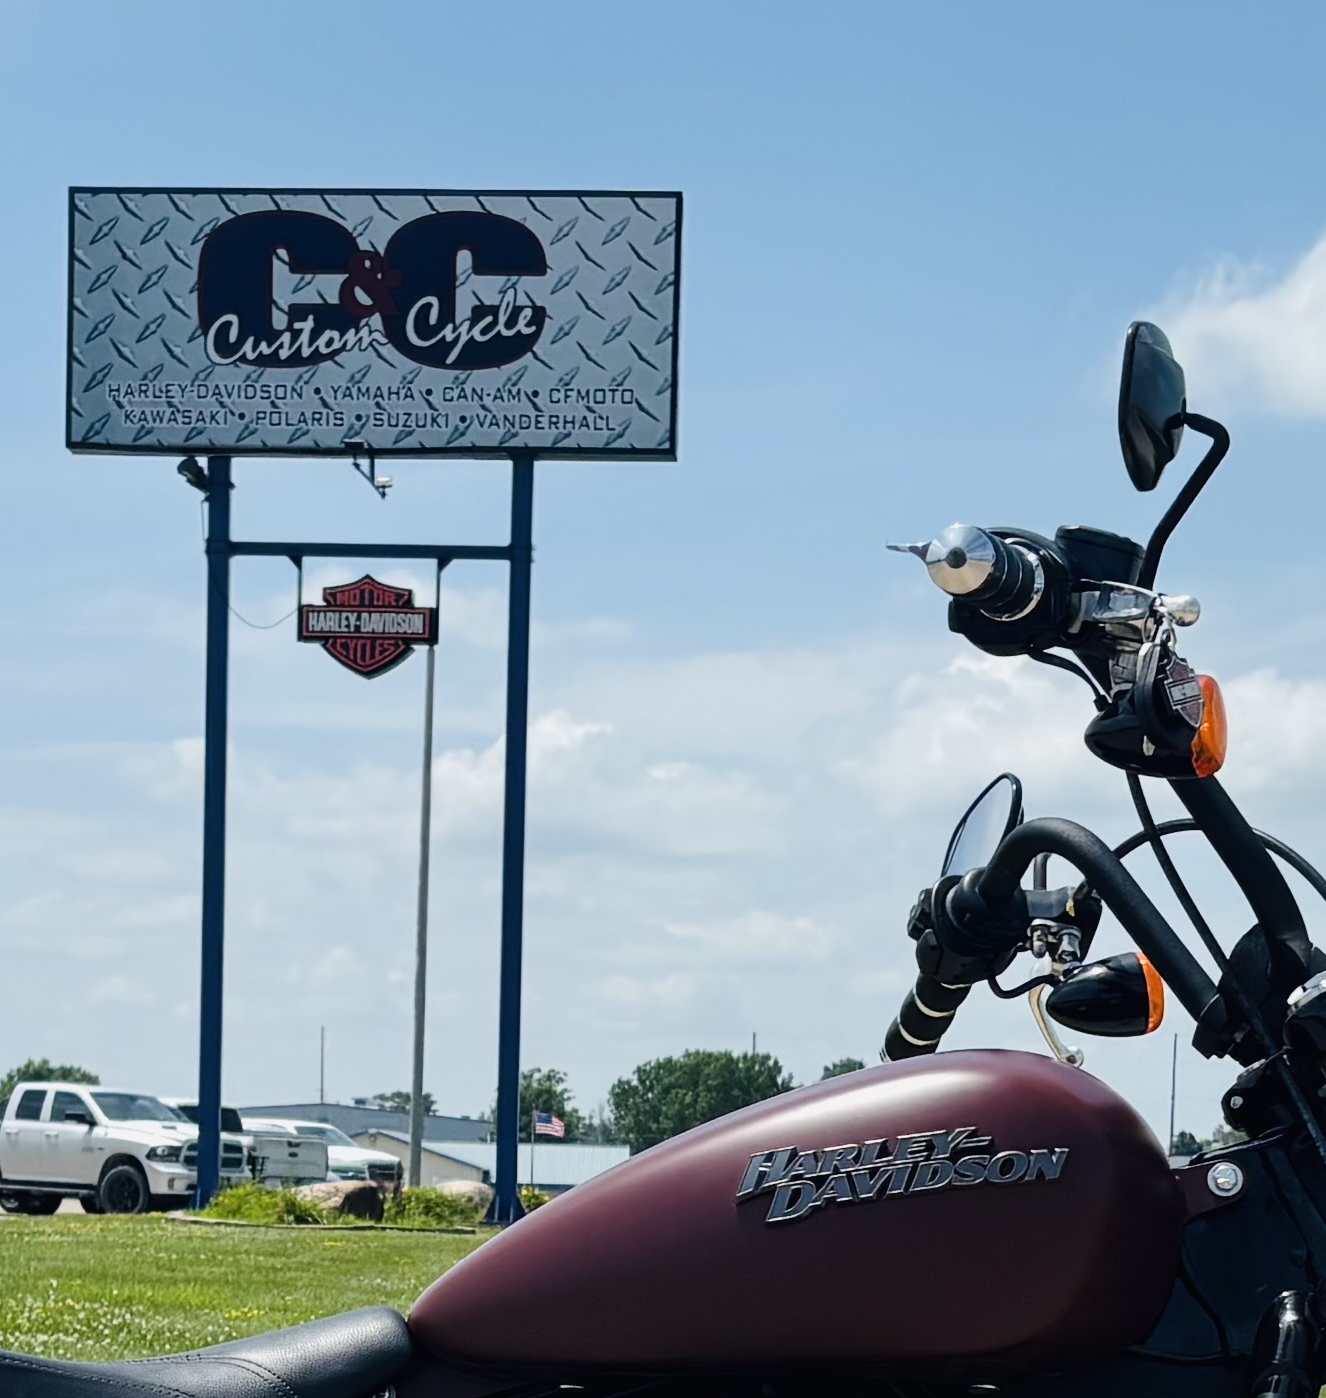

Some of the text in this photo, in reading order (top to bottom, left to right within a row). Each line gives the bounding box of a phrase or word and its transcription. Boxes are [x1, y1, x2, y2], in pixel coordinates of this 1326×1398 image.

[206, 286, 537, 365] Custom Cycle
[107, 383, 635, 405] HARLEY-DAVIDSON YAMAHA CAN-AM CFMOTO
[123, 409, 617, 431] KAWASAKI POLARIS SUZUKI VANDERHALL
[336, 584, 397, 606] MOTOR
[308, 611, 424, 634] HARLEY-DAVIDSON
[336, 638, 395, 666] CYCLES
[735, 1126, 992, 1202] HARLEY-
[765, 1147, 1069, 1222] DAVIDSON
